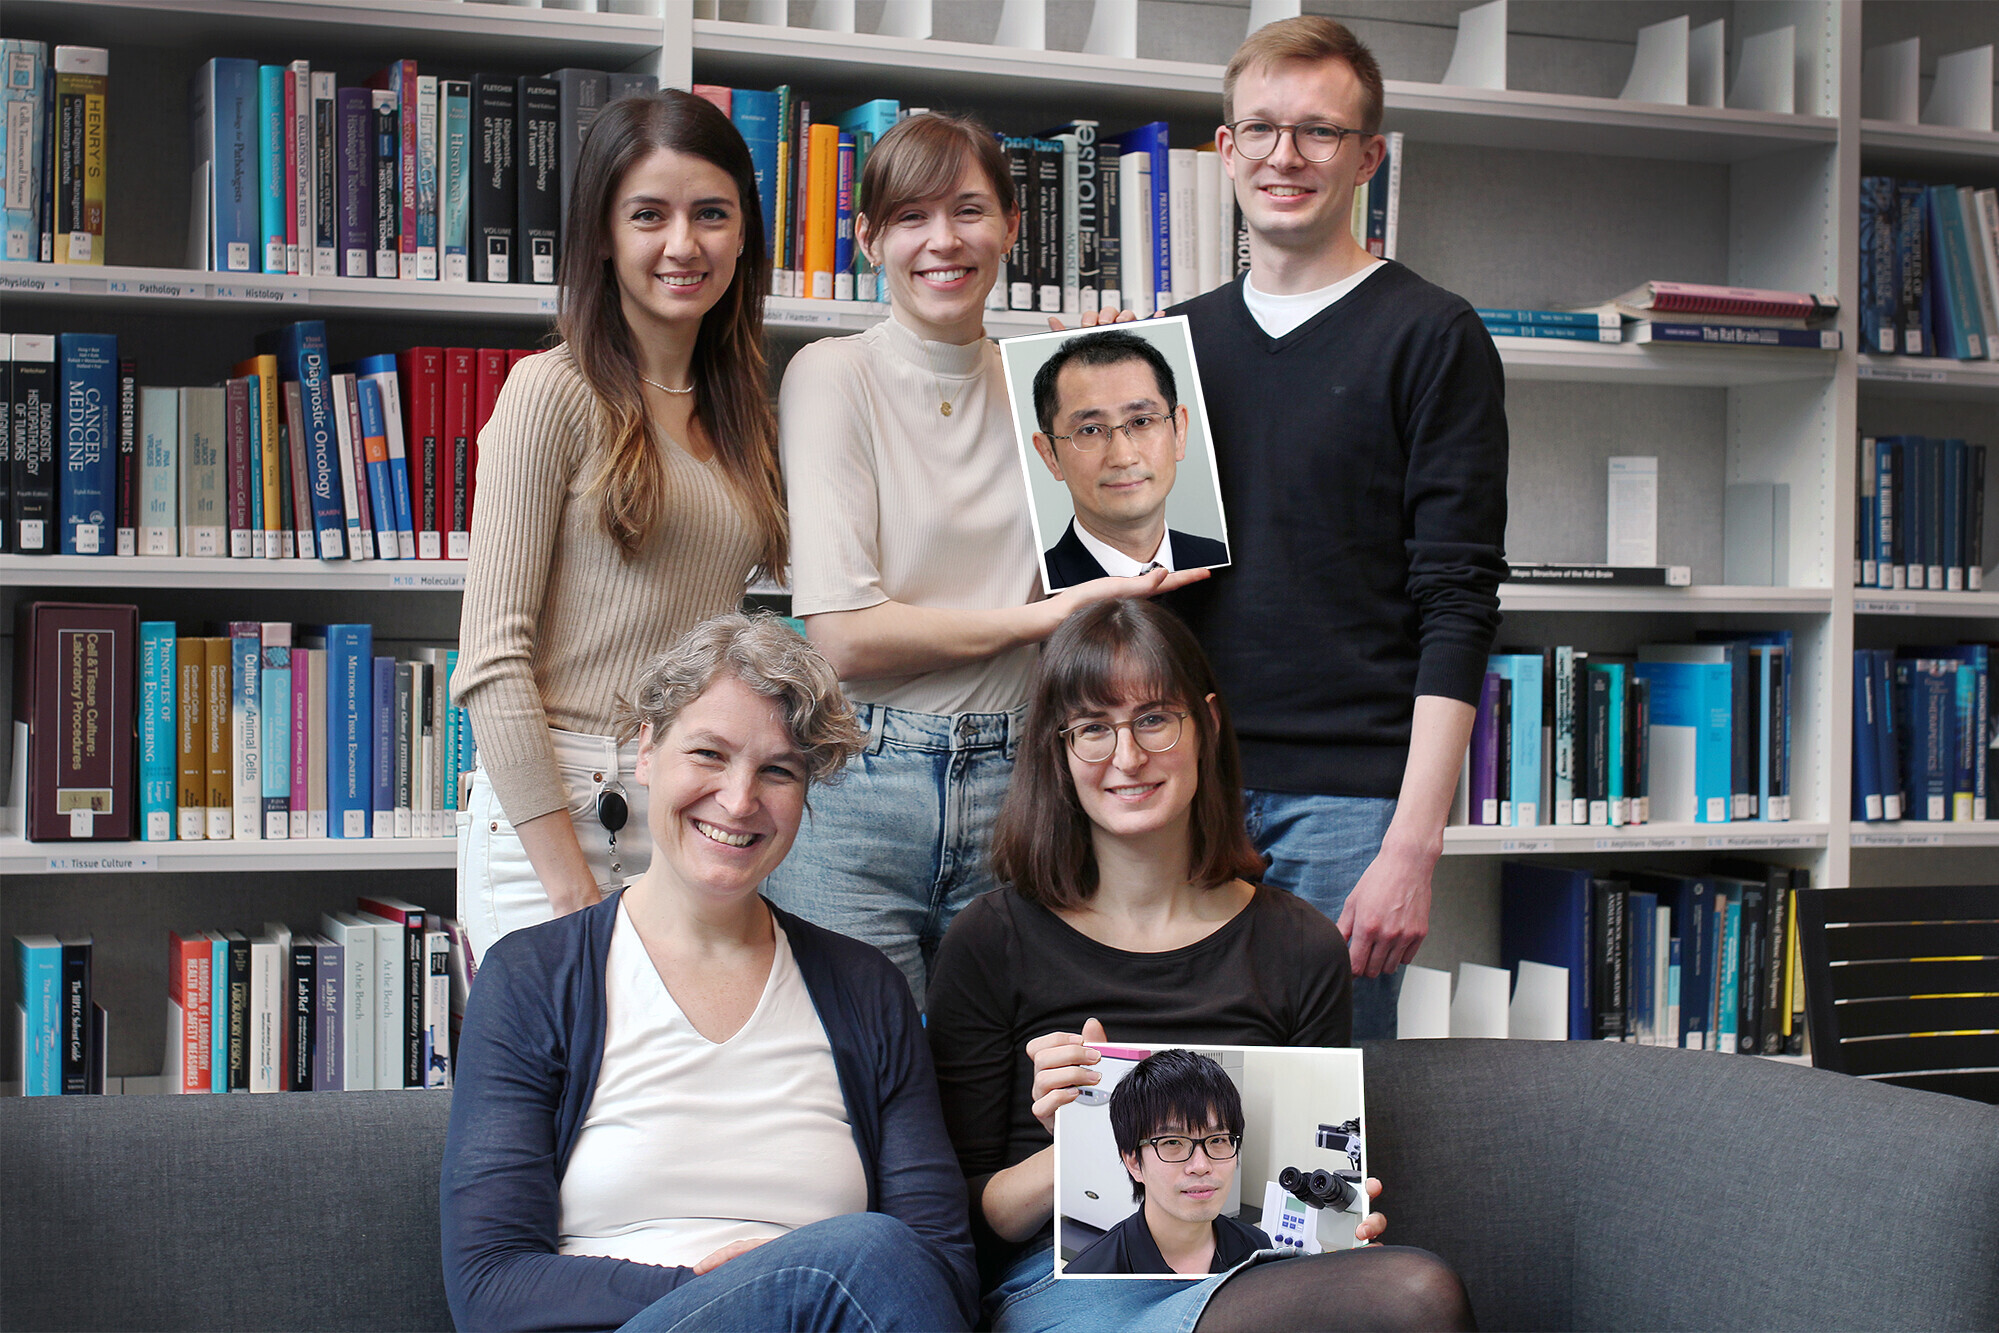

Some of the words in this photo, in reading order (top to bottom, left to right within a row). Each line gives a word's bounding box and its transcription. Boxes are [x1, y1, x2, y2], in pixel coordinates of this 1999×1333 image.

[483, 84, 513, 93] FLETCHER
[527, 87, 557, 96] FLETCHER
[62, 107, 72, 149] Laboratory
[73, 99, 82, 127] Clinical
[484, 117, 492, 127] of
[529, 120, 537, 130] of
[72, 128, 82, 165] Diagnosis
[89, 99, 101, 178] HENRY'S
[271, 112, 280, 152] Lehrbuch
[298, 114, 307, 165] EVALUATION
[345, 114, 359, 171] Histological
[420, 103, 435, 186] HISTOLOGY
[483, 128, 492, 164] Tumors
[502, 119, 511, 168] Diagnostic
[546, 121, 556, 170] Diagnostic
[492, 117, 503, 189] Histopathology
[528, 132, 537, 167] Tumors
[537, 120, 548, 191] Histopathology
[62, 150, 72, 185] Methods
[232, 143, 245, 203] Pathologists
[269, 154, 281, 198] Histologie
[298, 166, 307, 179] OF
[404, 154, 414, 210] HISTOLOGY
[450, 133, 464, 204] HISTOLOGY
[72, 179, 82, 230] Management
[299, 181, 307, 197] THE
[346, 174, 359, 227] Techniques
[839, 191, 849, 211] RAT
[299, 198, 308, 227] TESTIS
[1158, 191, 1168, 235] PRENATAL
[483, 227, 512, 235] VOLUME
[528, 229, 556, 237] VOLUME
[1159, 237, 1169, 267] MOUSE
[0, 278, 46, 290] Physiology
[110, 282, 129, 292] M.3.
[139, 284, 181, 295] Pathology
[217, 287, 236, 297] M.4.
[245, 289, 284, 300] Histology
[1702, 326, 1718, 341] The
[1720, 326, 1735, 342] Rat
[1736, 327, 1760, 344] Brain
[306, 354, 328, 428] Diagnostic
[14, 402, 26, 417] OF
[68, 379, 85, 472] MEDICINE
[84, 387, 101, 465] CANCER
[121, 376, 134, 453] ONCOGENOMICS
[234, 404, 243, 424] Atlas
[14, 419, 26, 461] TUMORS
[27, 389, 39, 475] HISTOPATHOLOGY
[40, 403, 51, 462] DIAGNOSTIC
[235, 425, 244, 435] of
[265, 401, 275, 454] Histopathology
[146, 433, 154, 467] VIRUSES
[235, 435, 244, 463] Human
[314, 430, 332, 499] Oncology
[424, 437, 434, 485] Molecular
[454, 438, 465, 485] Molecular
[236, 464, 244, 490] Tumor
[237, 491, 246, 506] Cell
[424, 487, 434, 531] Medicine
[453, 487, 464, 531] Medicine
[237, 507, 246, 527] Lines
[393, 577, 416, 585] M.10.
[420, 577, 459, 585] Molecular
[87, 633, 99, 658] Cell
[143, 636, 158, 678] TISSUE
[71, 633, 84, 699] Laboratory
[160, 637, 174, 703] PRINCIPLES
[244, 654, 257, 696] Culture
[348, 655, 358, 698] METHODS
[245, 697, 255, 710] of
[274, 677, 287, 715] Culture
[348, 699, 357, 711] OF
[434, 685, 442, 717] CULTURE
[144, 681, 158, 762] ENGINEERING
[161, 705, 171, 722] OF
[245, 710, 258, 750] Animal
[348, 712, 358, 741] TISSUE
[434, 718, 442, 728] OF
[71, 700, 84, 770] Procedures
[86, 707, 98, 757] Culture:
[184, 732, 192, 753] Media
[211, 732, 219, 753] Media
[274, 728, 287, 763] Animal
[245, 753, 258, 781] Cells
[447, 725, 455, 781] IMMORTALIZED
[274, 764, 287, 789] Cells
[348, 743, 358, 798] ENGINEERING
[433, 788, 441, 810] CELLS
[447, 783, 455, 805] CELLS
[1517, 841, 1538, 851] Phage
[50, 859, 68, 868] N.1.
[71, 858, 99, 868] Tissue
[101, 858, 133, 869] Culture
[187, 958, 198, 989] HEALTH
[198, 958, 209, 1004] HANDBOOK
[355, 960, 365, 972] At
[355, 973, 365, 989] the
[383, 959, 393, 971] At
[383, 972, 393, 987] the
[410, 962, 420, 996] Essential
[71, 980, 81, 994] The
[187, 991, 198, 1009] AND
[383, 988, 393, 1018] Bench
[71, 994, 81, 1016] HPLC
[198, 1004, 209, 1016] OF
[231, 982, 242, 1037] LABORATORY
[355, 991, 365, 1020] Bench
[409, 997, 420, 1037] Laboratory
[187, 1010, 198, 1040] SAFETY
[198, 1017, 209, 1071] LABORATORY
[231, 1038, 242, 1070] DESIGN
[410, 1039, 419, 1081] Techniques
[186, 1041, 198, 1087] MEASURES
